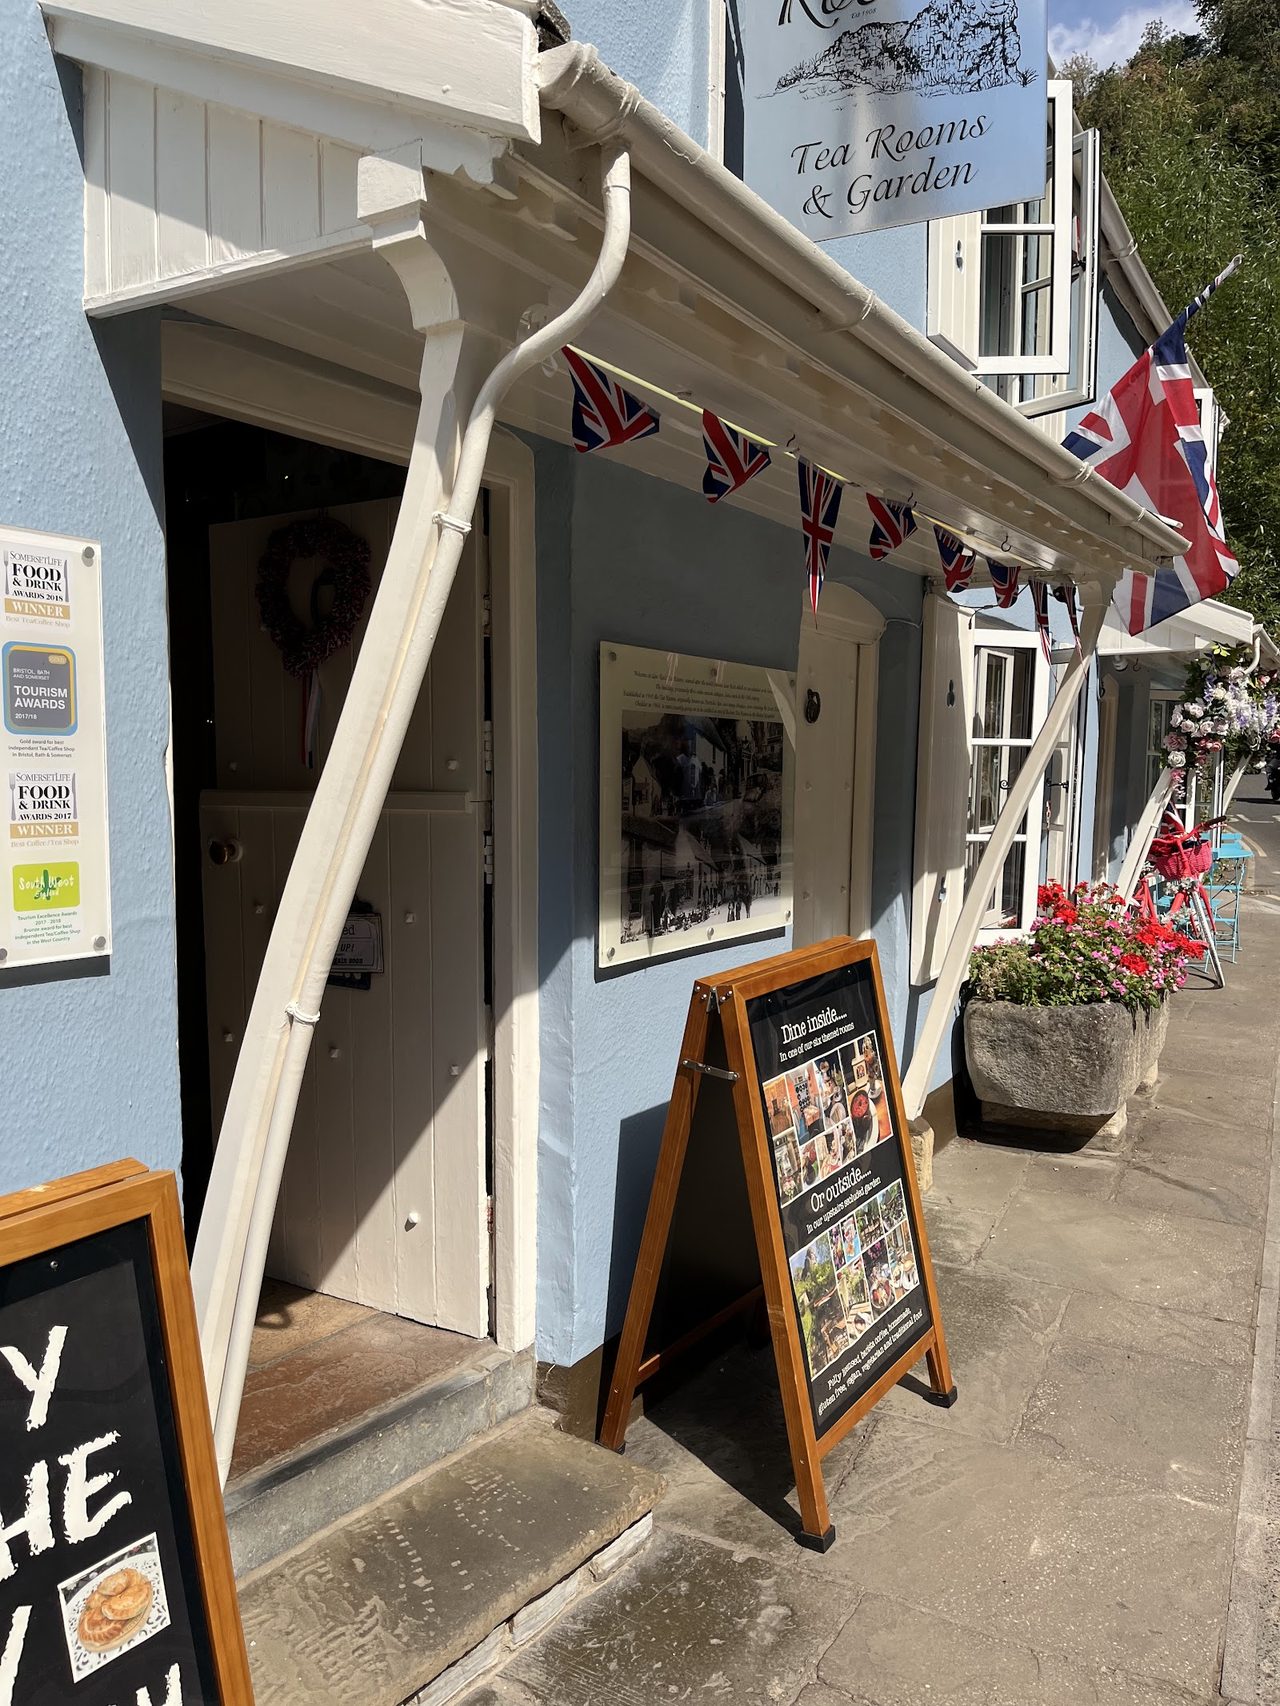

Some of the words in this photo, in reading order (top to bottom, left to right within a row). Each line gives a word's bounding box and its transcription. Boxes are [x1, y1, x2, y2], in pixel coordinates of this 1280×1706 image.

[791, 140, 855, 175] Tea
[865, 114, 993, 162] Rooms
[802, 184, 835, 219] &
[847, 157, 979, 215] Garden
[12, 563, 62, 582] FOOD
[12, 577, 21, 587] &
[26, 578, 62, 592] DRINK
[12, 589, 45, 600] AWARDS
[46, 593, 64, 602] 2018
[12, 600, 64, 618] WINNER
[14, 685, 68, 698] TOURISM
[14, 697, 66, 710] AWARDS
[18, 785, 70, 800] FOOD
[18, 800, 28, 810] &
[32, 800, 71, 810] DRINK
[18, 813, 52, 821] AWARDS
[54, 812, 71, 820] 2017
[17, 824, 73, 836] WINNER
[781, 1021, 807, 1044] Dine
[779, 1052, 788, 1062] In
[788, 1048, 798, 1059] one
[798, 1043, 804, 1054] of
[804, 1040, 813, 1051] our
[813, 1037, 822, 1047] six
[821, 1027, 839, 1043] themed
[839, 1022, 855, 1035] rooms
[806, 1224, 814, 1234] In
[813, 1216, 823, 1229] our
[822, 1202, 845, 1222] upstairs
[844, 1186, 865, 1208] secluded
[864, 1176, 882, 1195] garden
[811, 1192, 825, 1212] Or
[860, 1341, 875, 1359] barista
[861, 1346, 885, 1372] vegetarian
[884, 1336, 893, 1351] and
[891, 1316, 914, 1343] traditional
